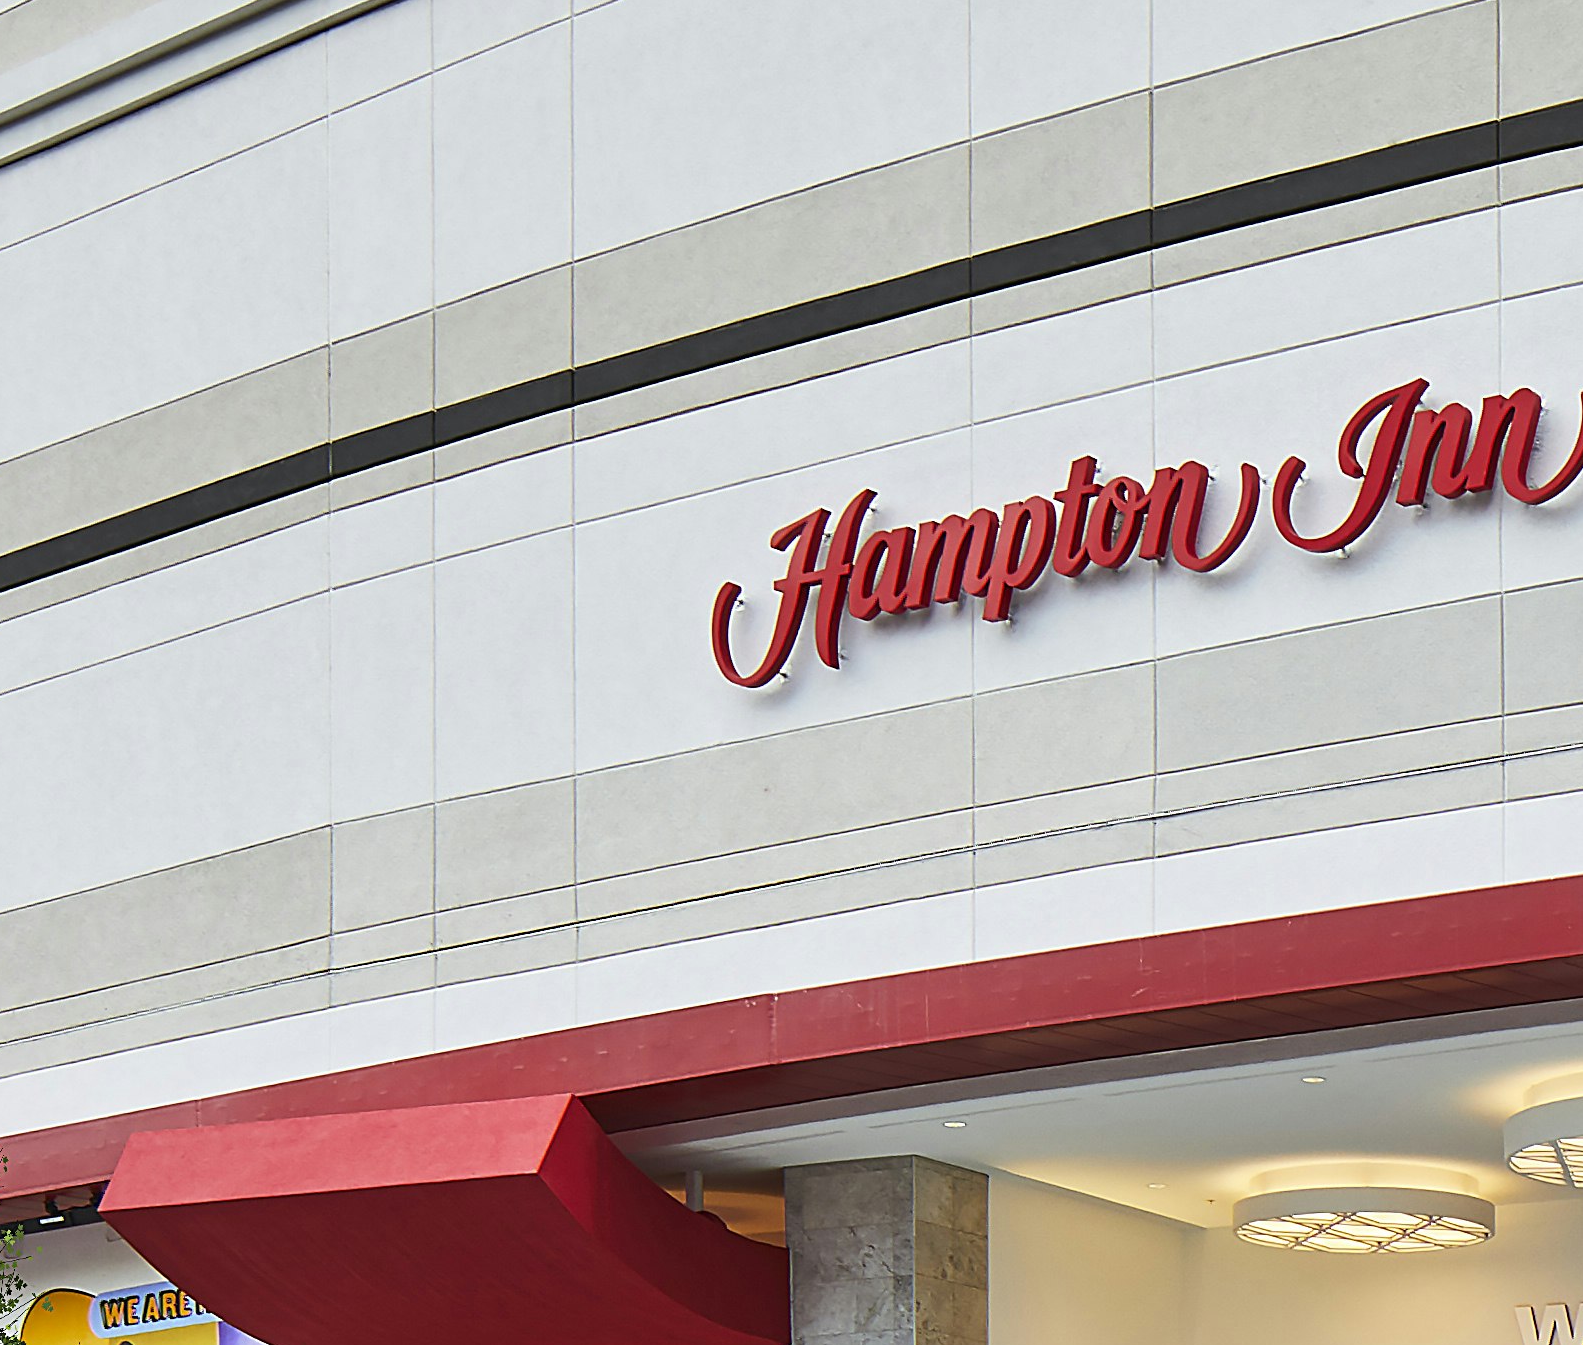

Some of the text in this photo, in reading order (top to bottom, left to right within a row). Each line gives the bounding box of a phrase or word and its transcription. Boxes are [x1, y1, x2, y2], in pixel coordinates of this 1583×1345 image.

[713, 455, 1259, 689] Hampton
[99, 1295, 140, 1330] WE
[142, 1288, 193, 1324] ARE
